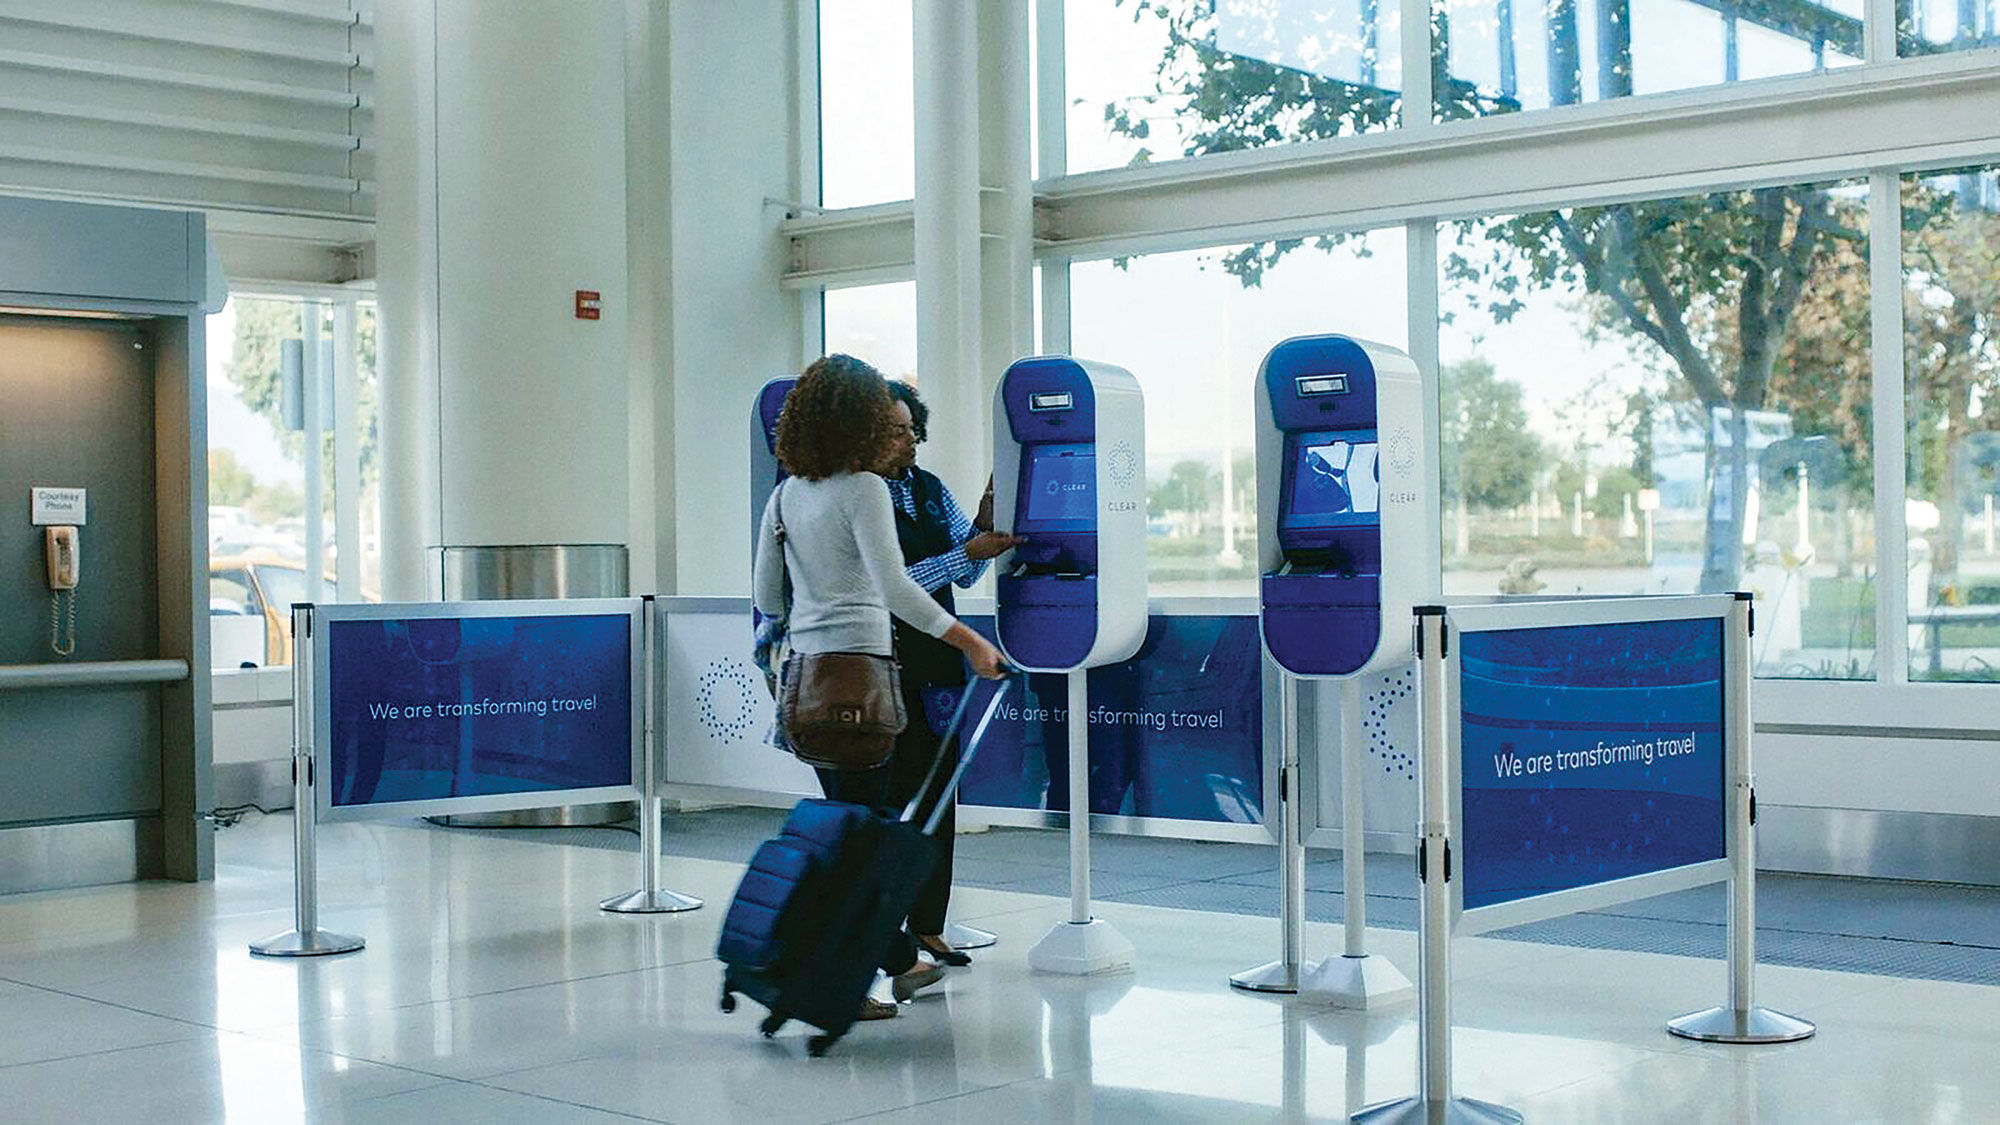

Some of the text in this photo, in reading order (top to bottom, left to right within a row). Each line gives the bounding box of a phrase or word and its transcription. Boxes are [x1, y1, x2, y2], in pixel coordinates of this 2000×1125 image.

[1061, 483, 1086, 491] CLEAR
[1107, 502, 1137, 511] CLEAR
[1390, 493, 1416, 503] CLEAR
[369, 694, 597, 719] We are transforming travel
[993, 704, 1223, 730] We are trsforming travel
[1494, 731, 1696, 778] We are transforming travel
